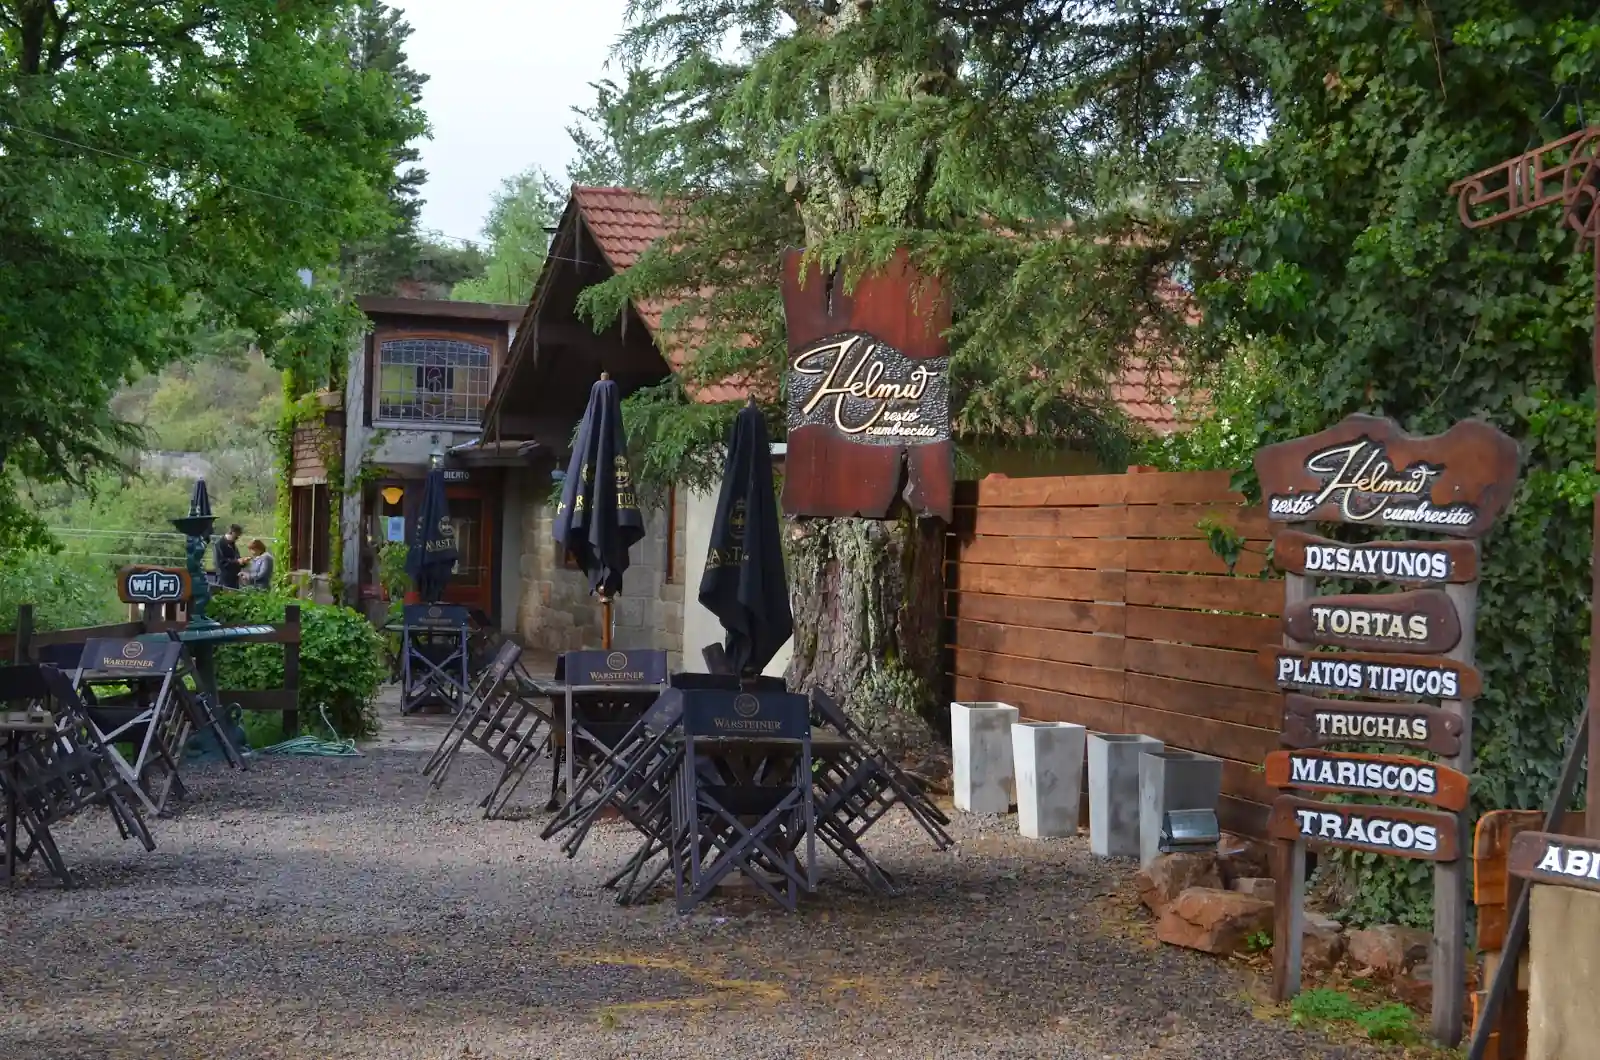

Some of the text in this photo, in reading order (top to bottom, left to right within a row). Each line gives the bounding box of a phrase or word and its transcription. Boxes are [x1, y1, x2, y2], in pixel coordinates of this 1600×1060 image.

[794, 335, 938, 433] Helmut
[865, 422, 937, 436] cumbrecita
[1308, 441, 1437, 520] Helmut
[1271, 495, 1474, 525] restó cumbrecita
[1305, 545, 1447, 578] DESAYUNOS
[1312, 607, 1428, 641] TORTAS
[103, 656, 155, 668] WARSTEINER
[589, 671, 645, 681] WARSTEINER
[1277, 657, 1458, 697] PLATOS TIPICOS
[713, 717, 782, 730] WARSTEINER
[1316, 713, 1428, 741] TRUCHAS
[1290, 757, 1437, 794] MARISCOS
[1296, 809, 1438, 852] TRAGOS
